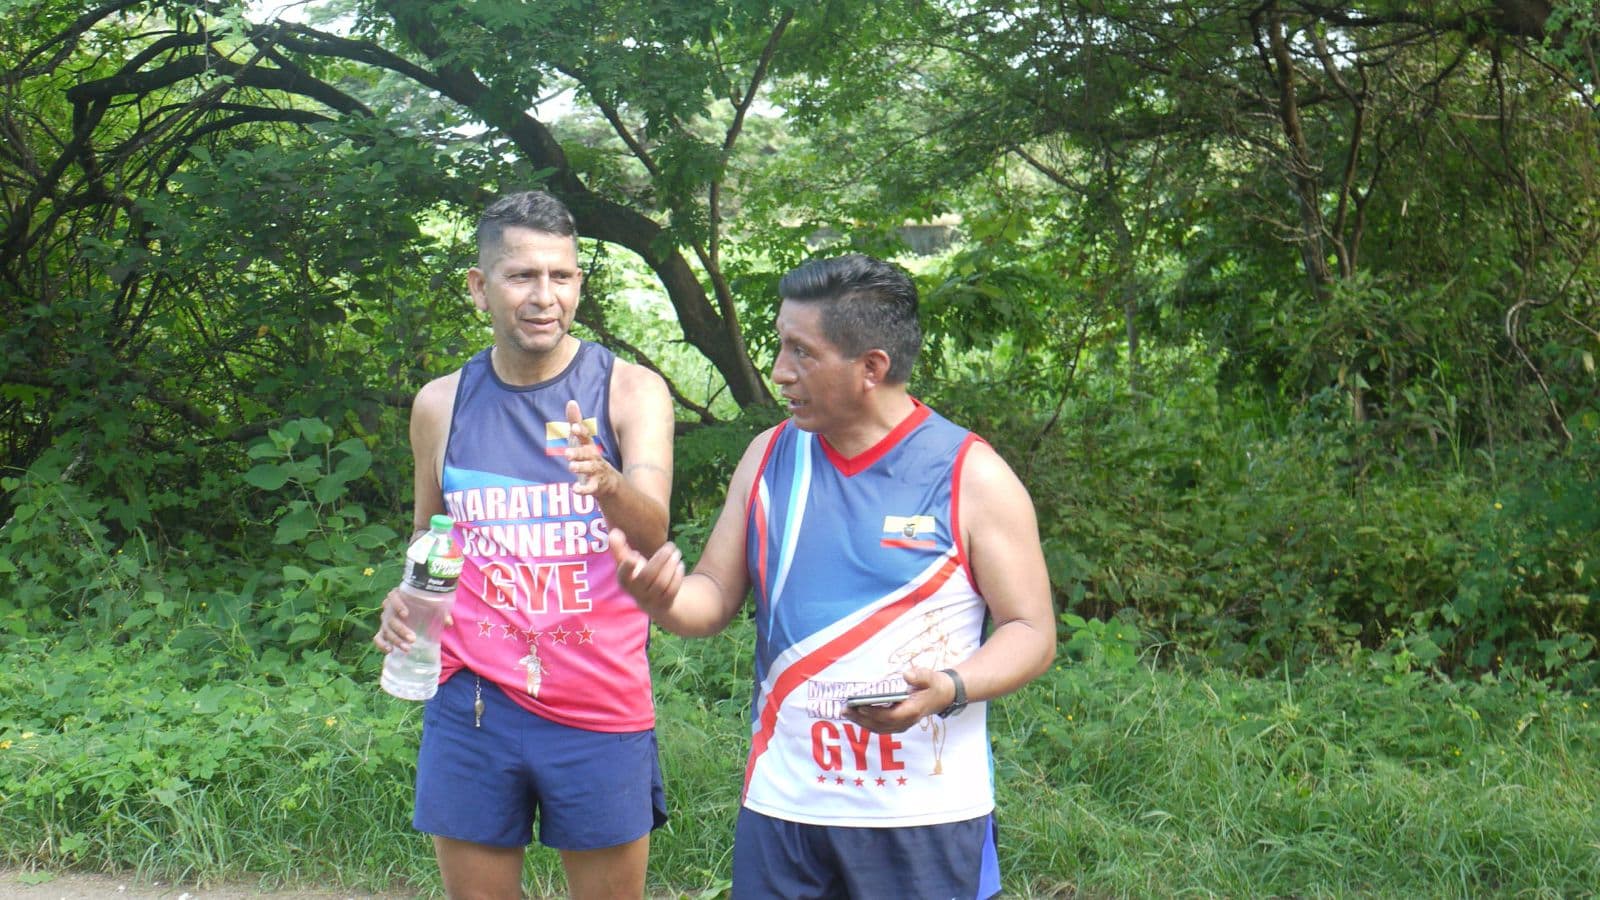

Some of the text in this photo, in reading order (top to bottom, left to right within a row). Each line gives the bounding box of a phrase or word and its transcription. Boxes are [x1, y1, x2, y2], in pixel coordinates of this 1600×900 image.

[446, 482, 602, 522] MARATHO
[462, 517, 609, 557] RUNNERS
[481, 561, 592, 614] GYE
[811, 720, 905, 771] GYE
